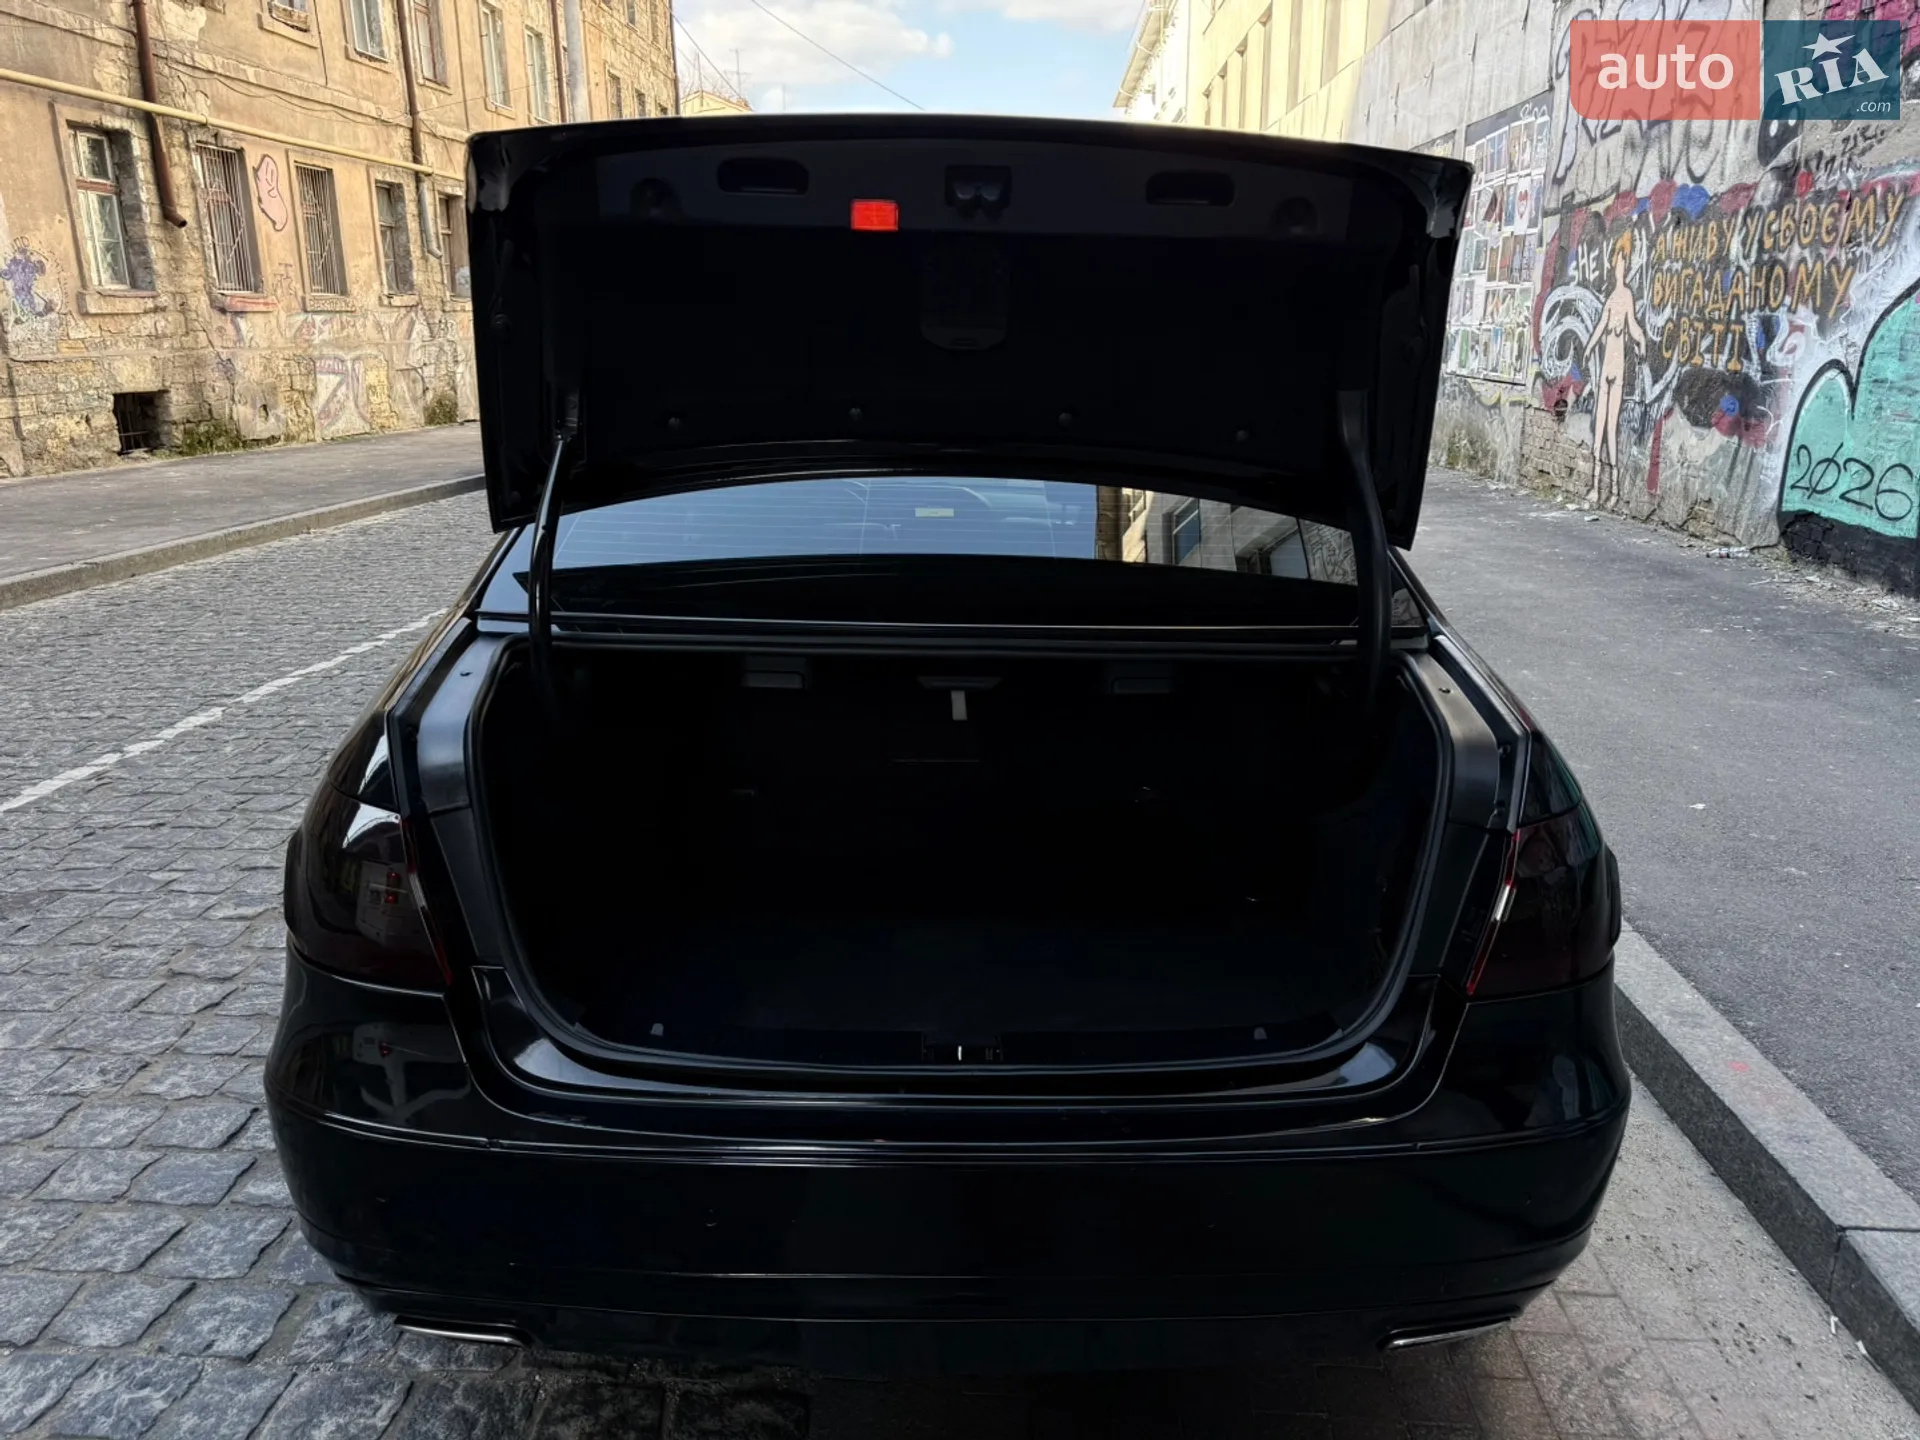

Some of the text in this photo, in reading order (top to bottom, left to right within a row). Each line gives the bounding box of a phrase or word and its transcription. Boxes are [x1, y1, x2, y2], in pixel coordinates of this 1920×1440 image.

[1652, 260, 1854, 320] ВИГАДАНОМУ
[1662, 316, 1744, 371] СВІТІ
[1790, 442, 1914, 520] 2026
